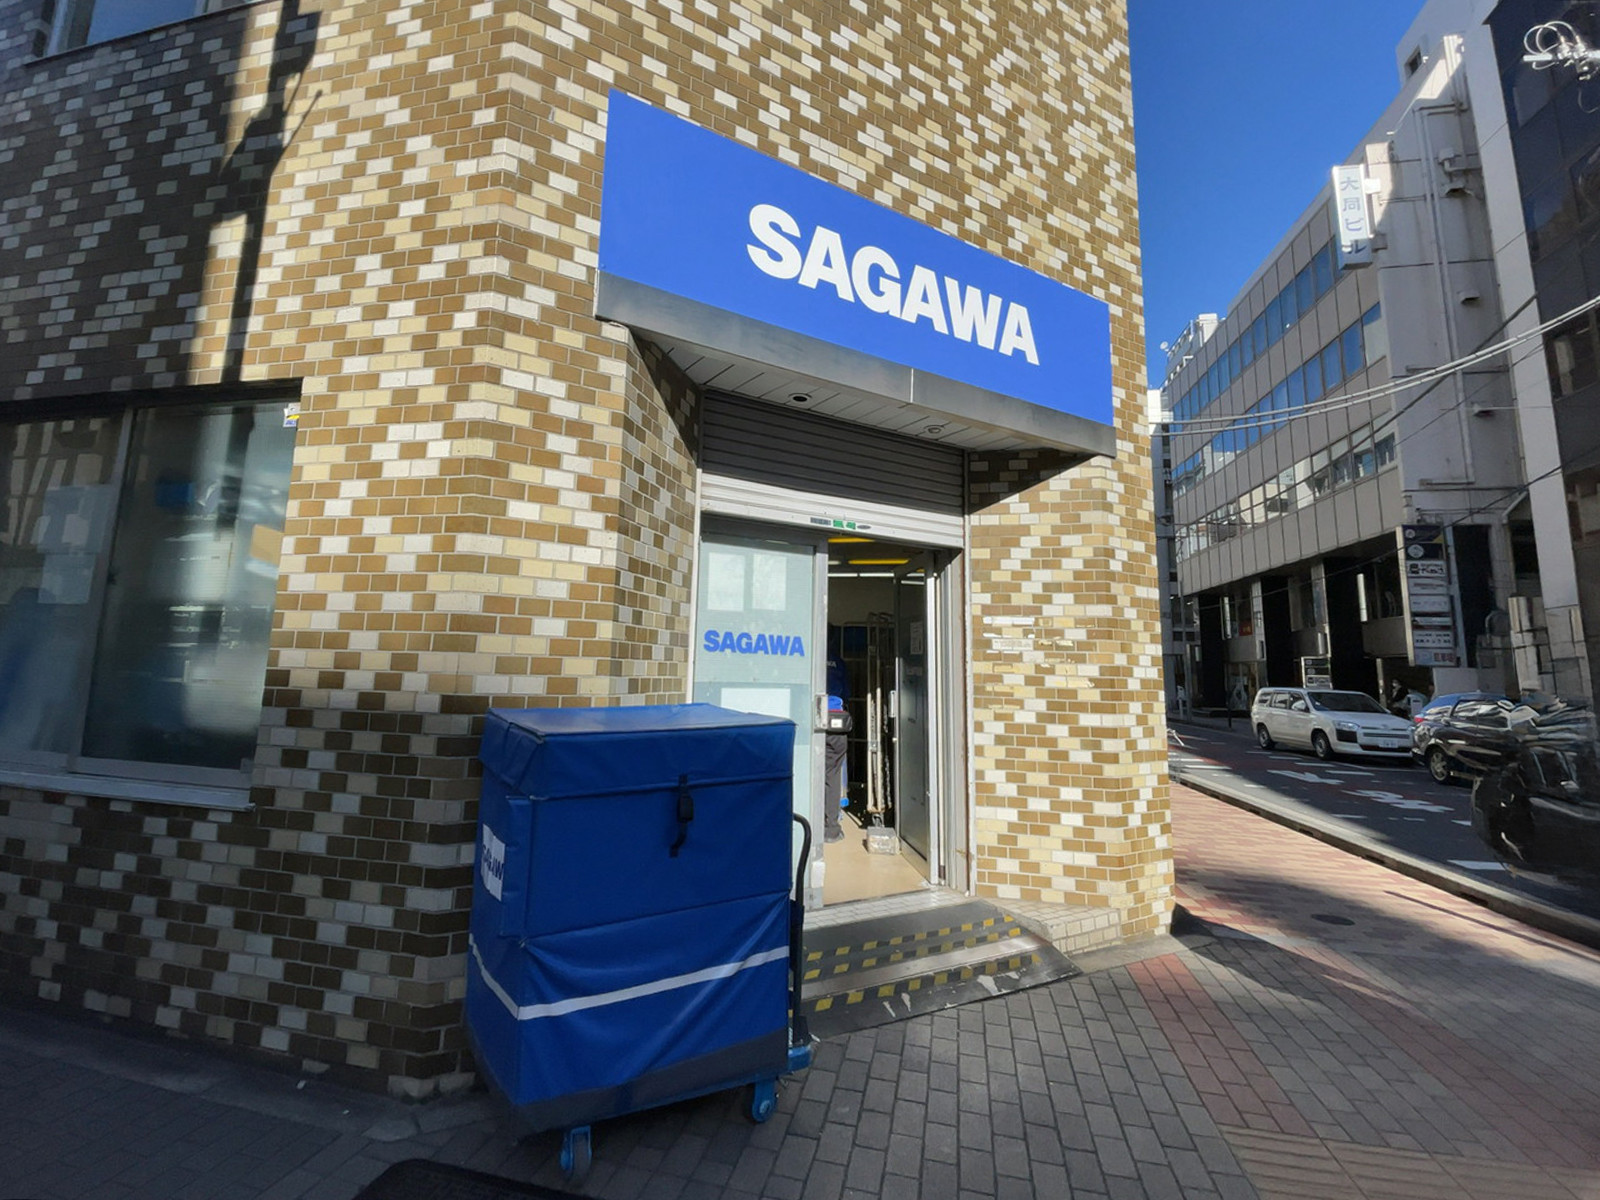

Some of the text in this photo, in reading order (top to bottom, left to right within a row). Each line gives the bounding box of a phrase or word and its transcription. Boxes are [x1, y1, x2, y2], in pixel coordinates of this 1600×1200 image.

[1340, 176, 1367, 254] 大同ビル
[746, 203, 1040, 366] SAGAWA
[703, 629, 805, 657] SAGAWA
